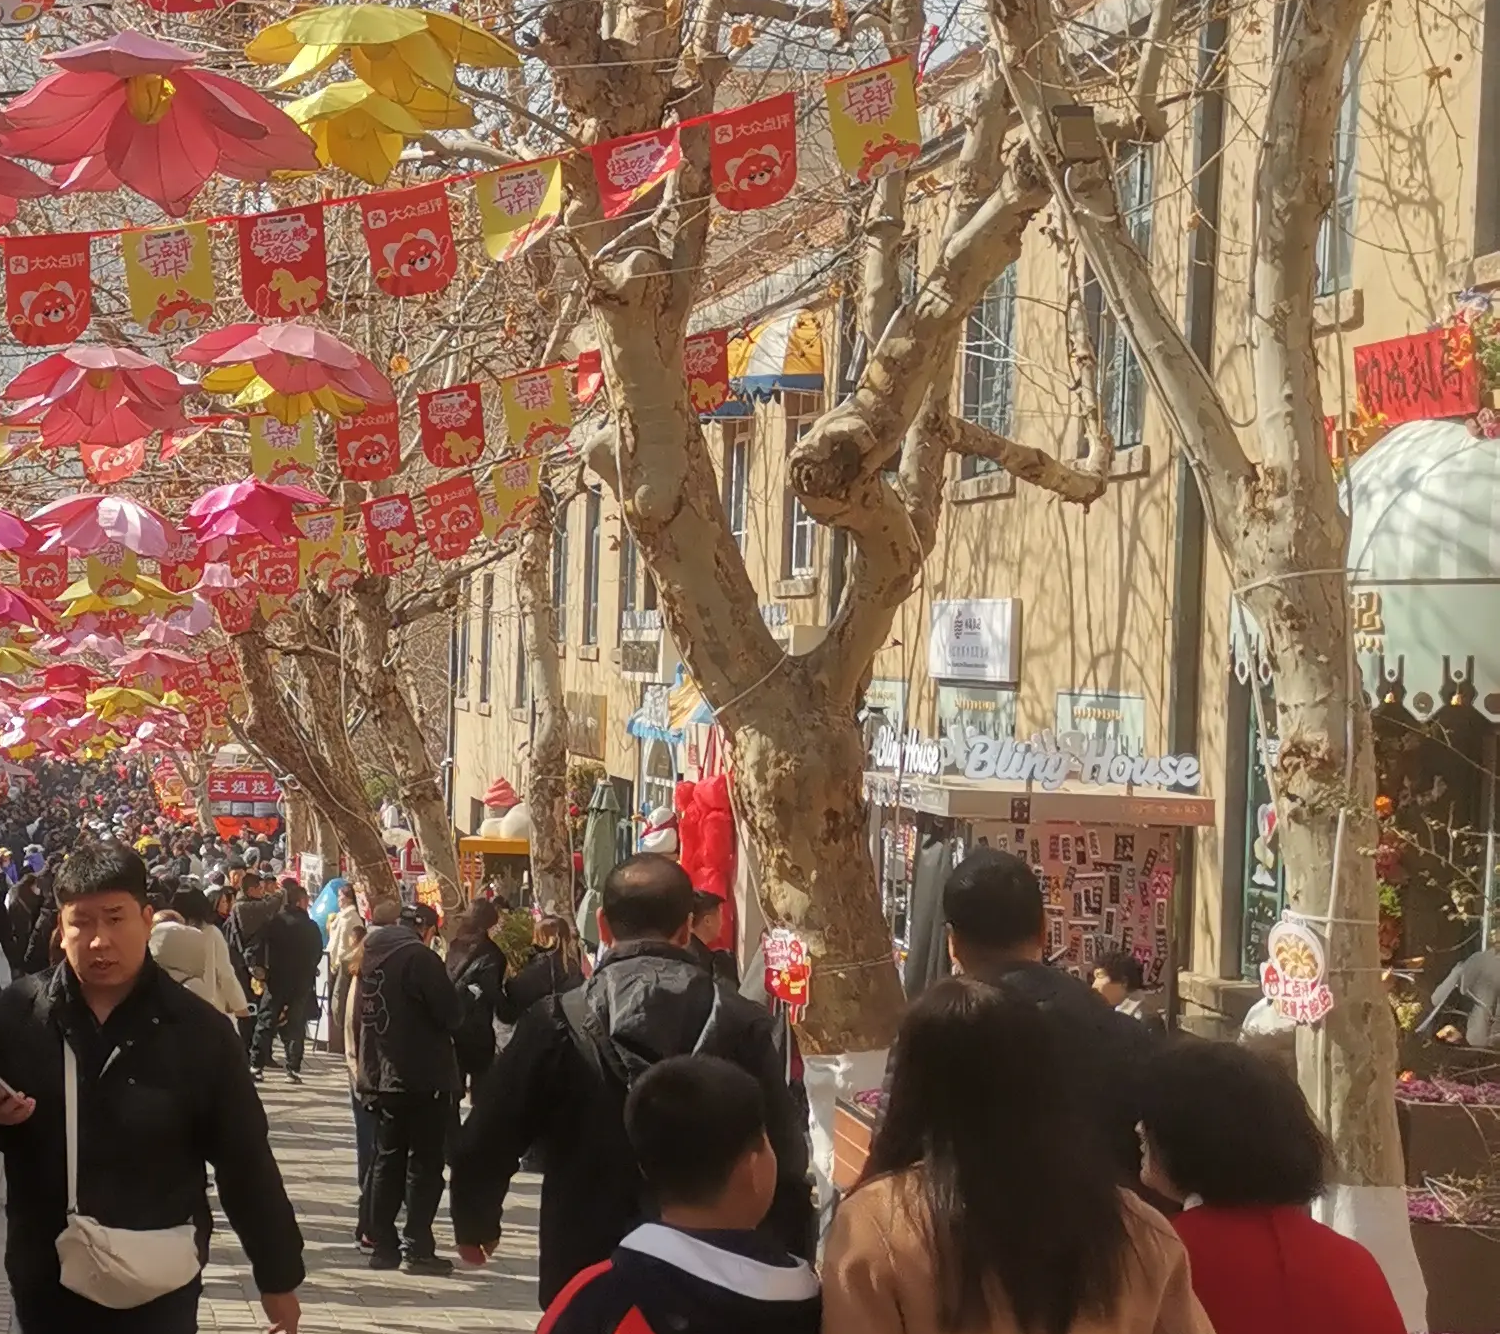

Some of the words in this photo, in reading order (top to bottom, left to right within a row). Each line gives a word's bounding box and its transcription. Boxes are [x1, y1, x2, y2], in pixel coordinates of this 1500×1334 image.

[842, 79, 896, 111] 上点评
[735, 113, 790, 139] 大众点评
[389, 197, 444, 224] 大众点评
[29, 252, 86, 272] 大众点评
[137, 237, 192, 265] 上点评
[150, 260, 185, 281] 打卡
[355, 412, 396, 428] 大众点评
[902, 727, 940, 775] House
[964, 733, 1072, 791] Bling
[1078, 733, 1202, 788] House
